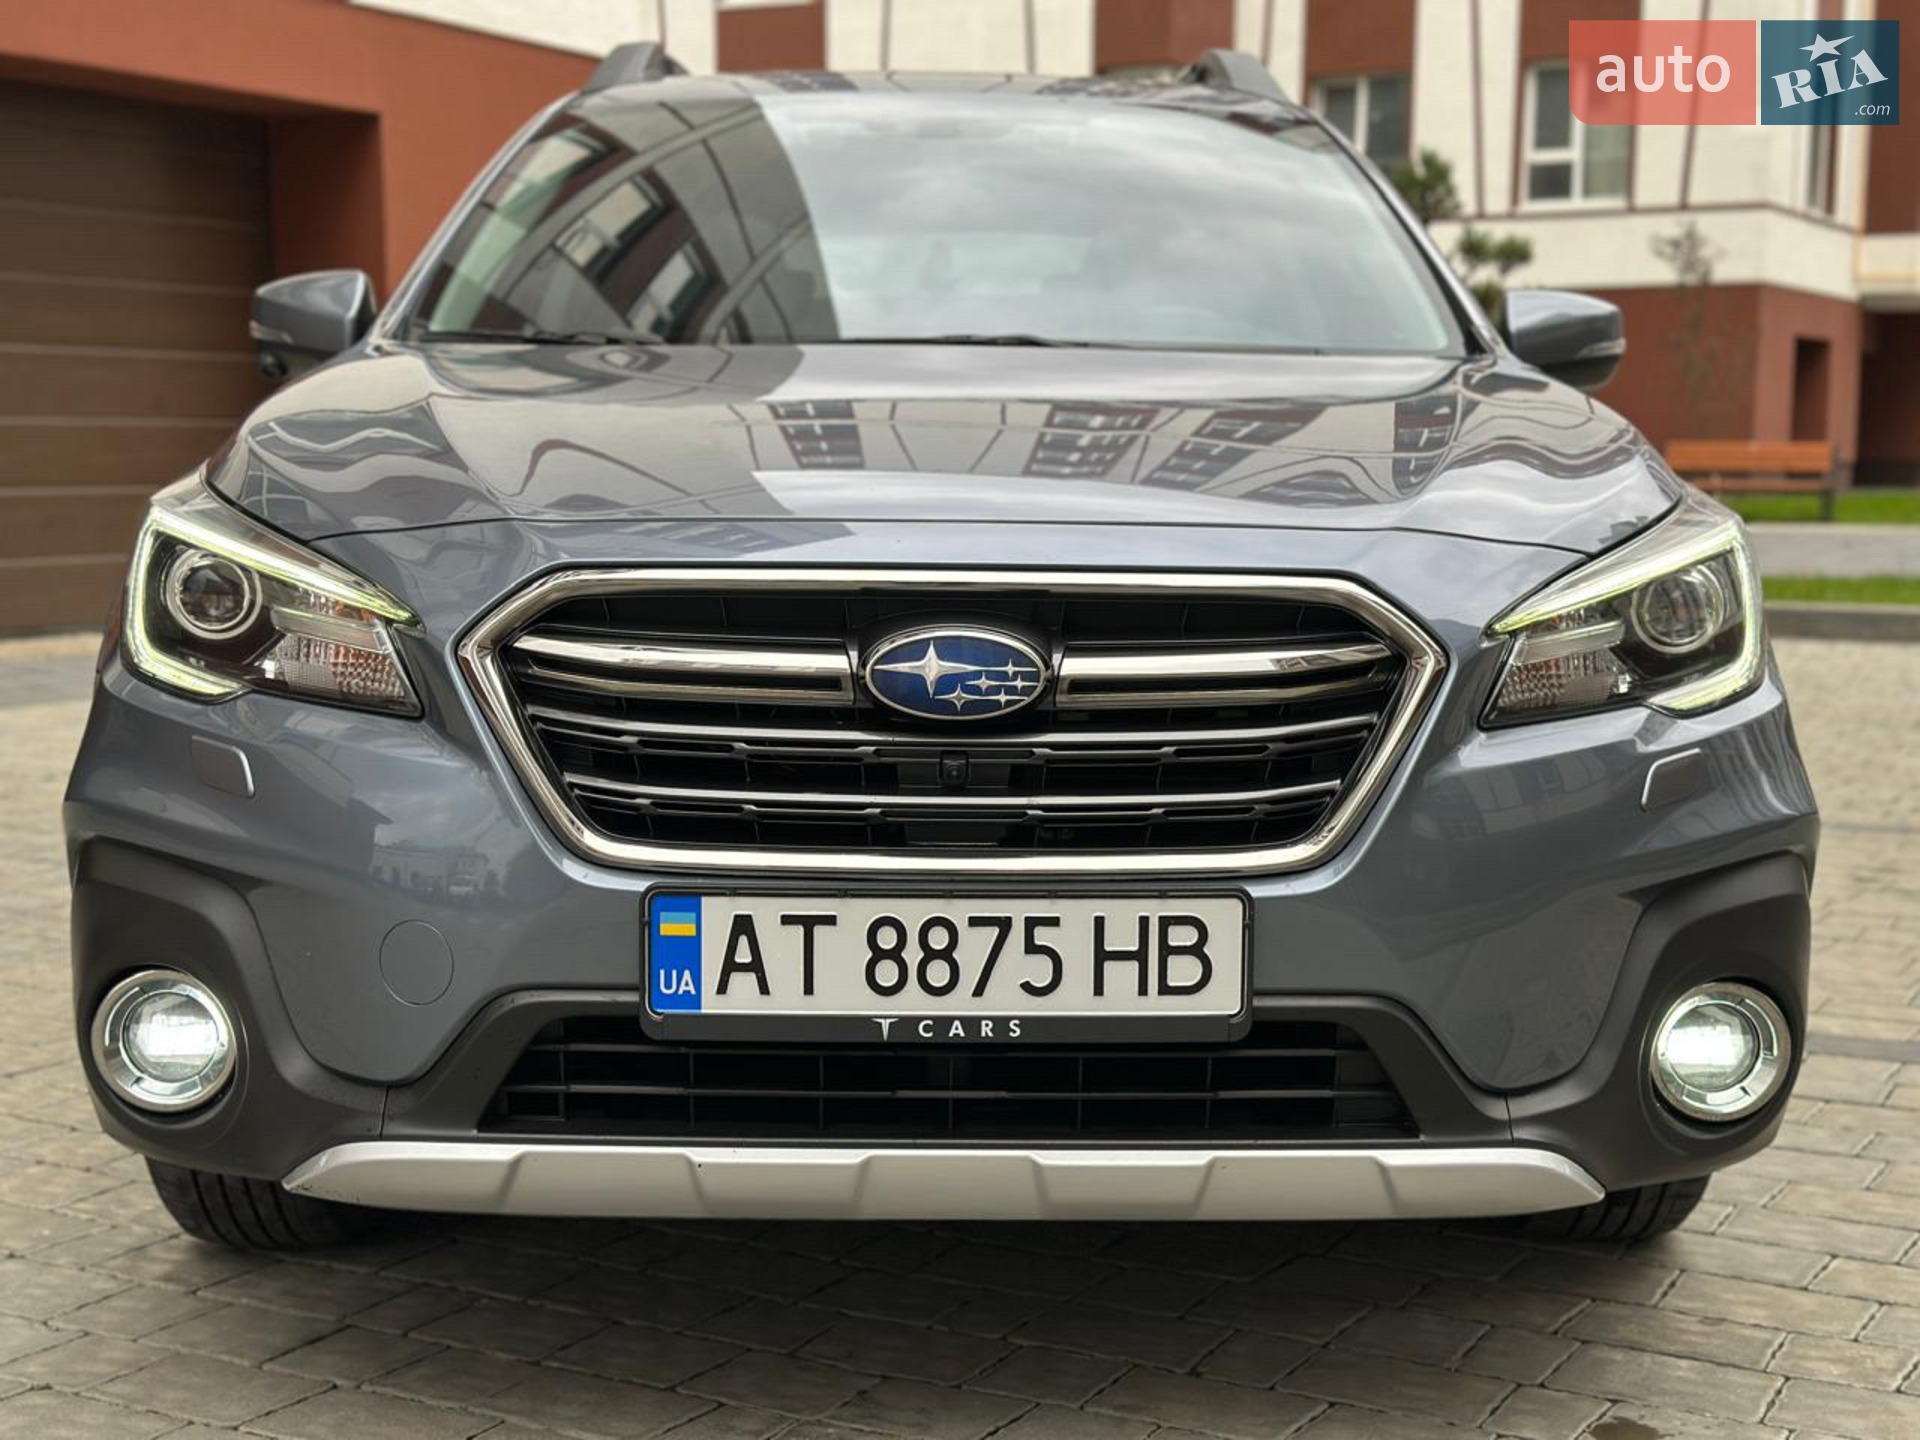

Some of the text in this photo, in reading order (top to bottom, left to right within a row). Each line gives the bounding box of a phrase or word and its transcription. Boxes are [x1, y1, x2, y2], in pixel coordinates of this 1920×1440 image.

[715, 914, 1213, 997] AT 8875 HB
[659, 969, 696, 995] UA
[918, 1018, 1021, 1038] CARS
